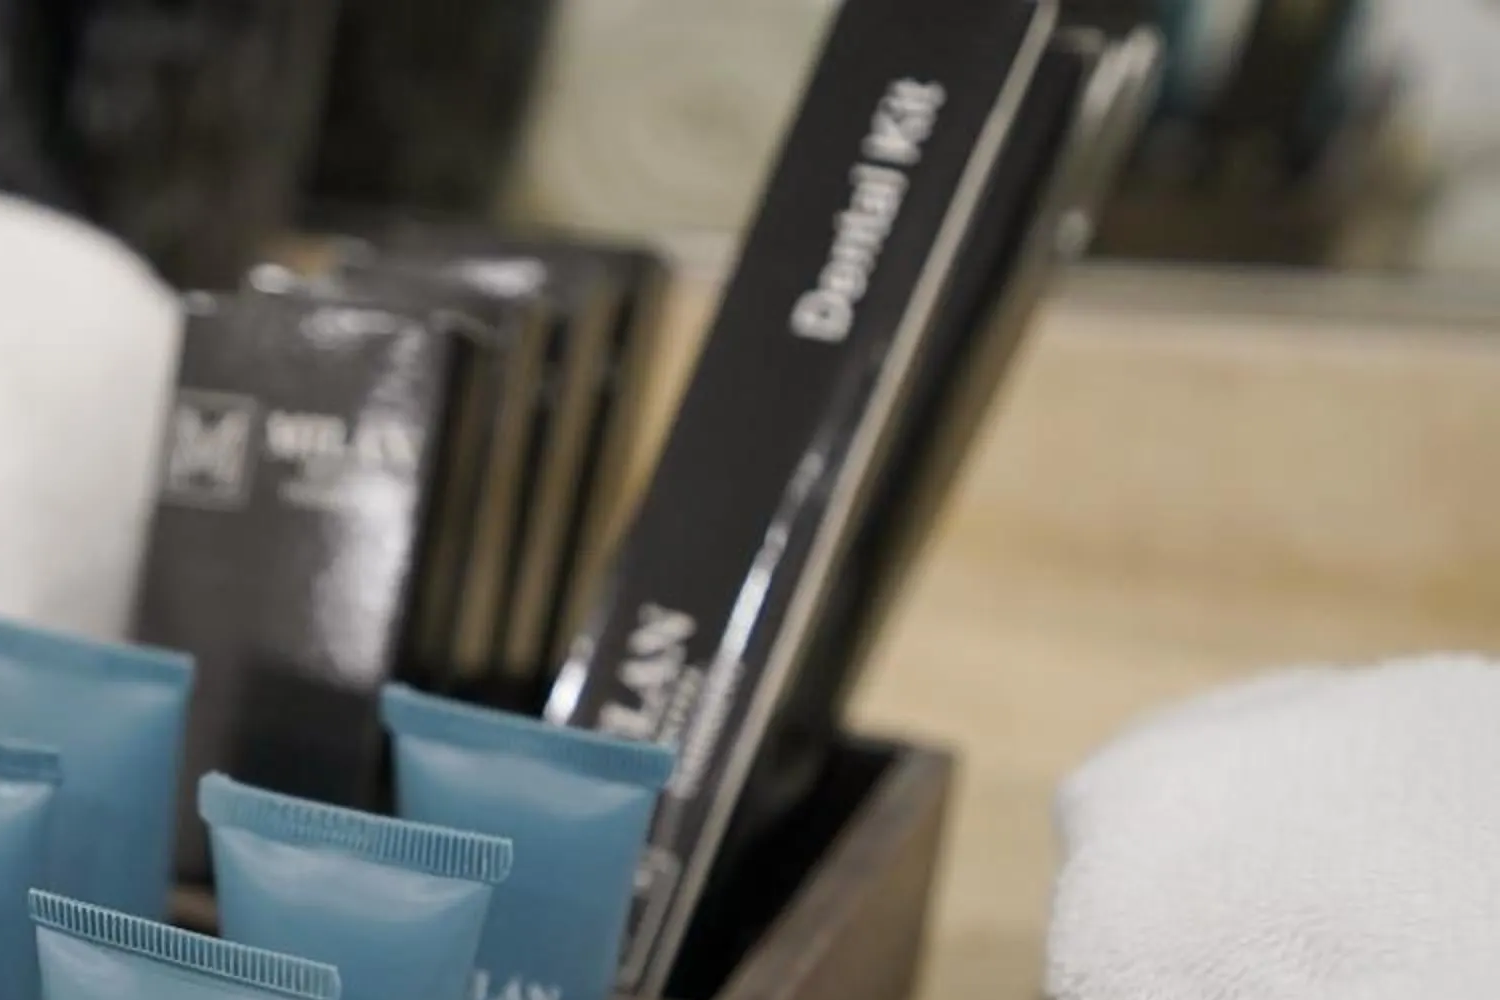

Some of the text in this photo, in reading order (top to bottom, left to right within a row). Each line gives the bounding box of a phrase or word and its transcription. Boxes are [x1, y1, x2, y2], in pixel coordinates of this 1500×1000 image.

[790, 77, 946, 341] Dental Kit
[600, 602, 697, 742] LAN
